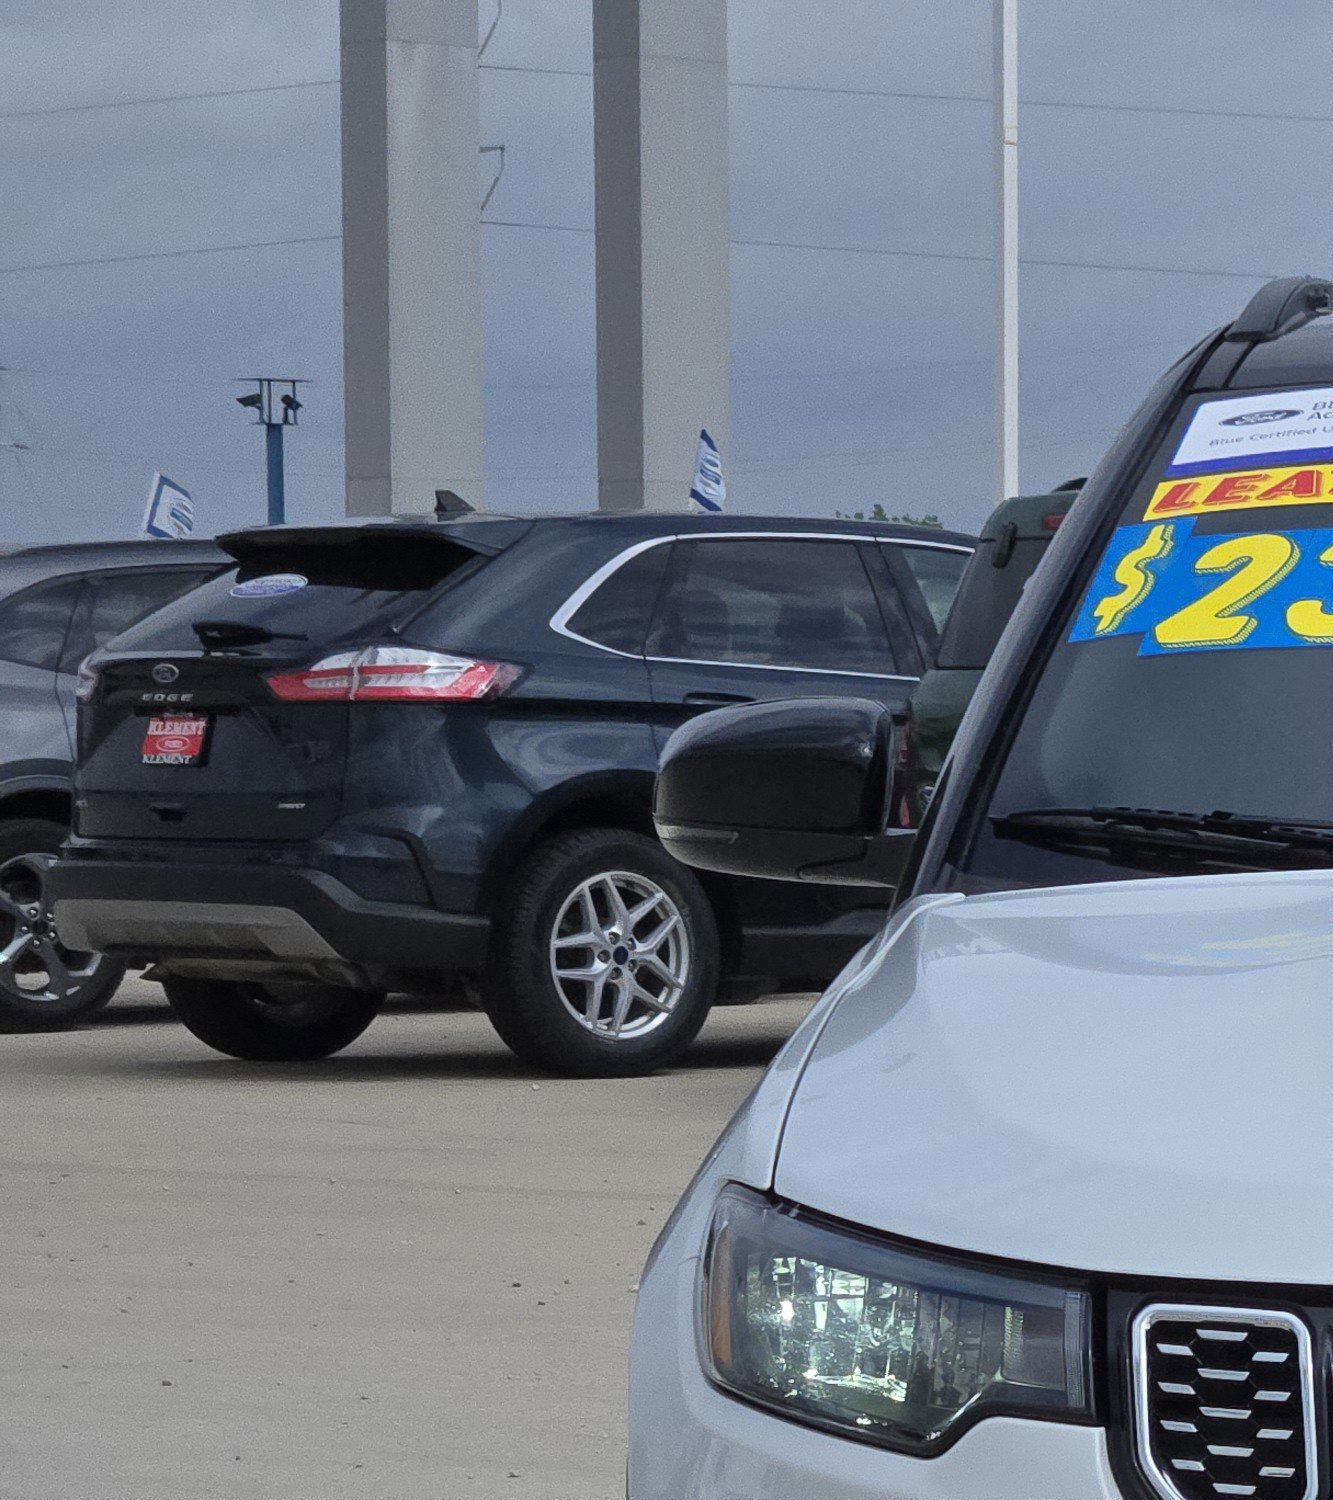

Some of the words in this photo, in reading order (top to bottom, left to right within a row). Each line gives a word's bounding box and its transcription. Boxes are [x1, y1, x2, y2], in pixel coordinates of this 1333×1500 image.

[1209, 437, 1244, 446] Blue
[1249, 427, 1317, 441] Certified
[141, 693, 194, 702] EDGE
[147, 720, 206, 735] KLEMENT
[142, 753, 193, 764] KLEMENT
